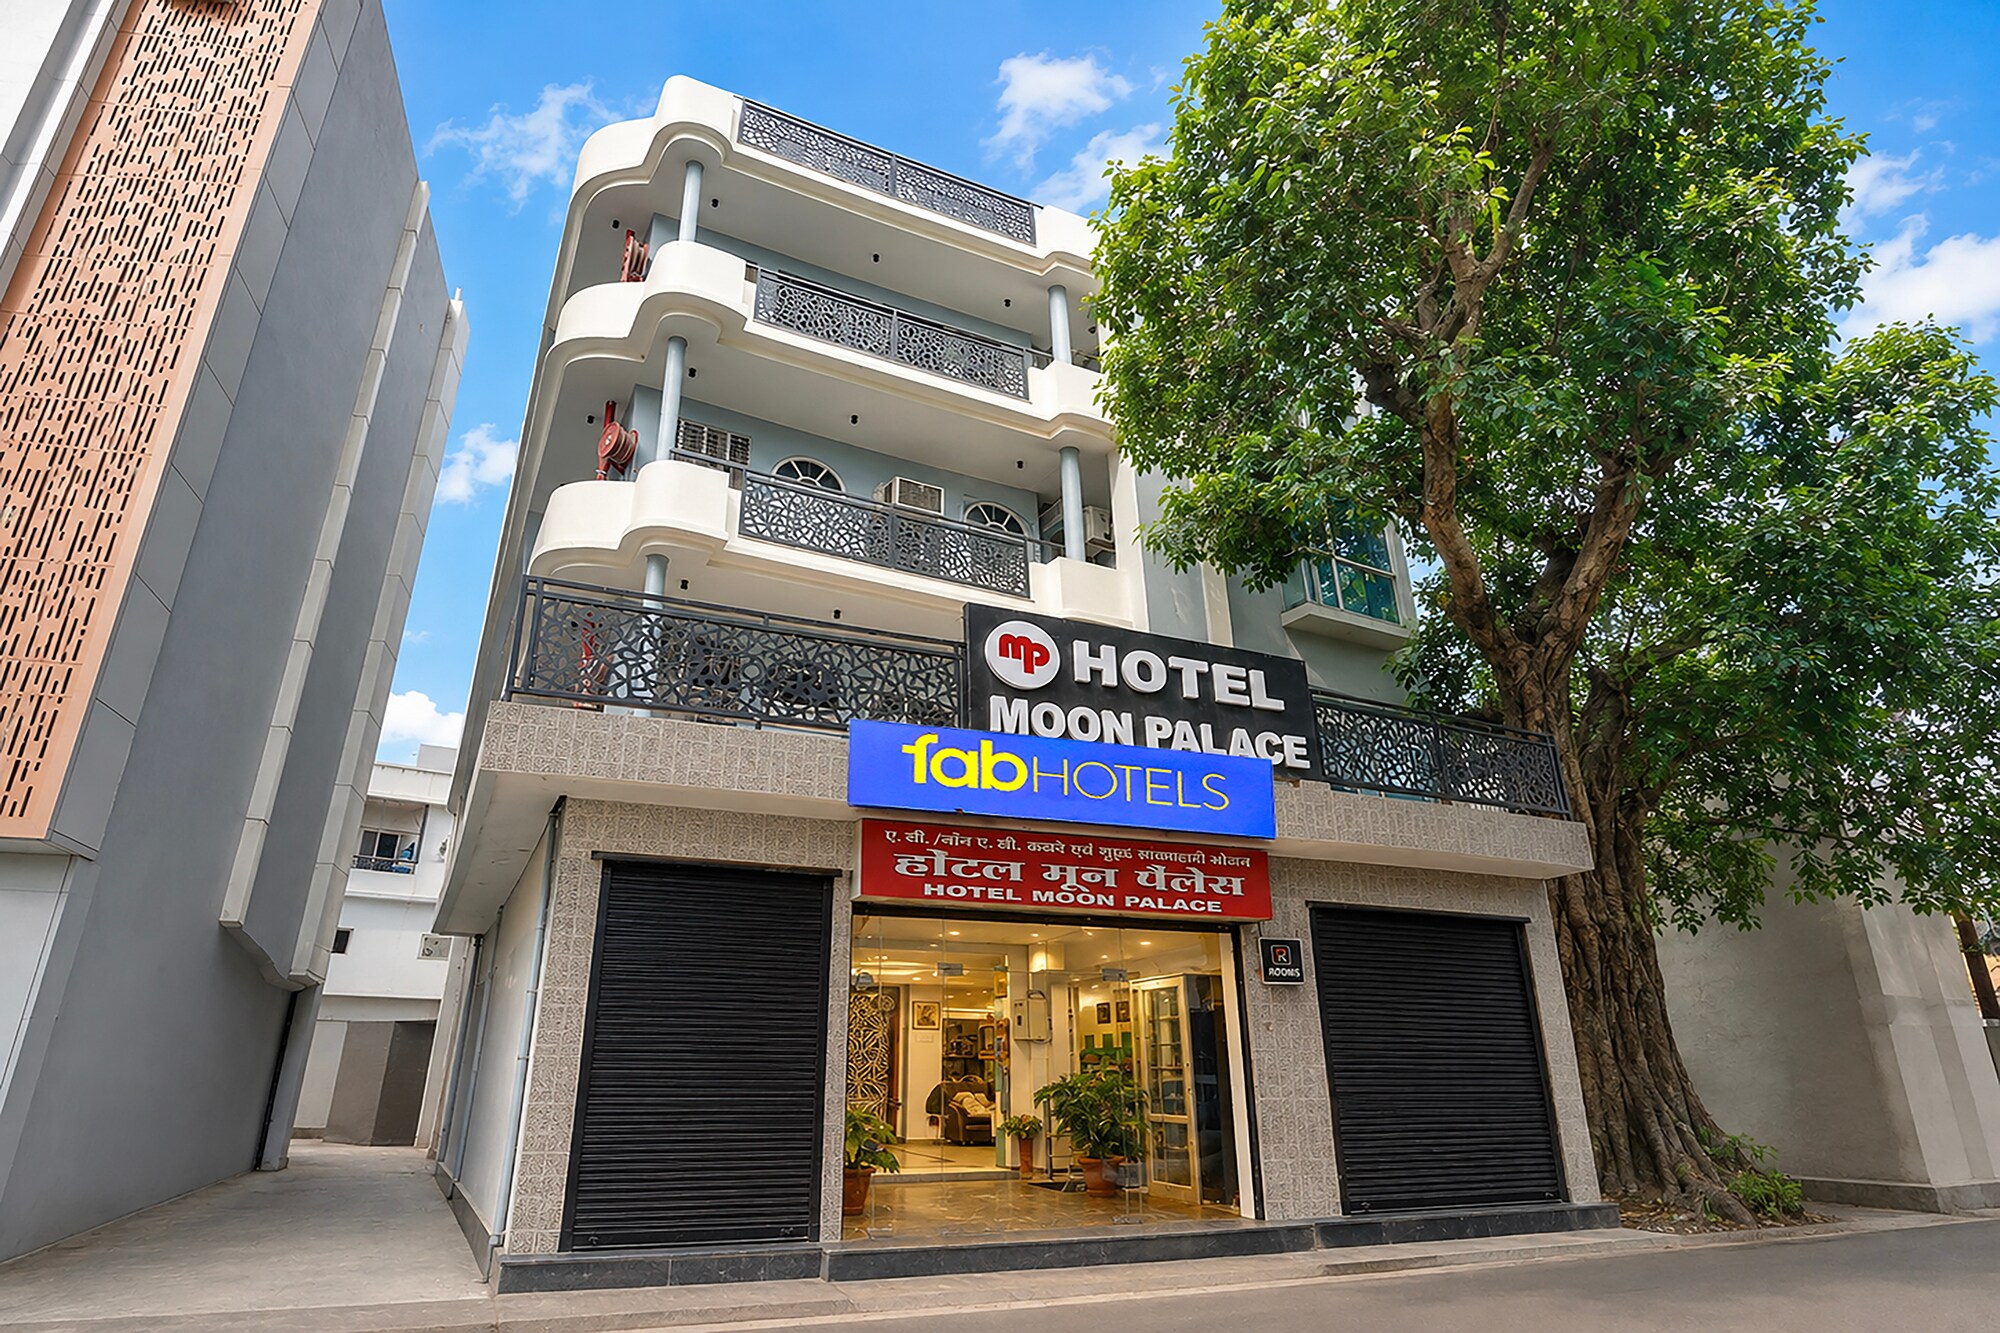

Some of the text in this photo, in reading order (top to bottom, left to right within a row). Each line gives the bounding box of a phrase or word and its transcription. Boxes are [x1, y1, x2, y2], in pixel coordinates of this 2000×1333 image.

[1072, 640, 1286, 712] HOTEL
[989, 695, 1312, 770] MOON PALACE
[894, 848, 1246, 896] होटल मून पैलेस
[924, 883, 1223, 913] HOTEL MOON PALACE
